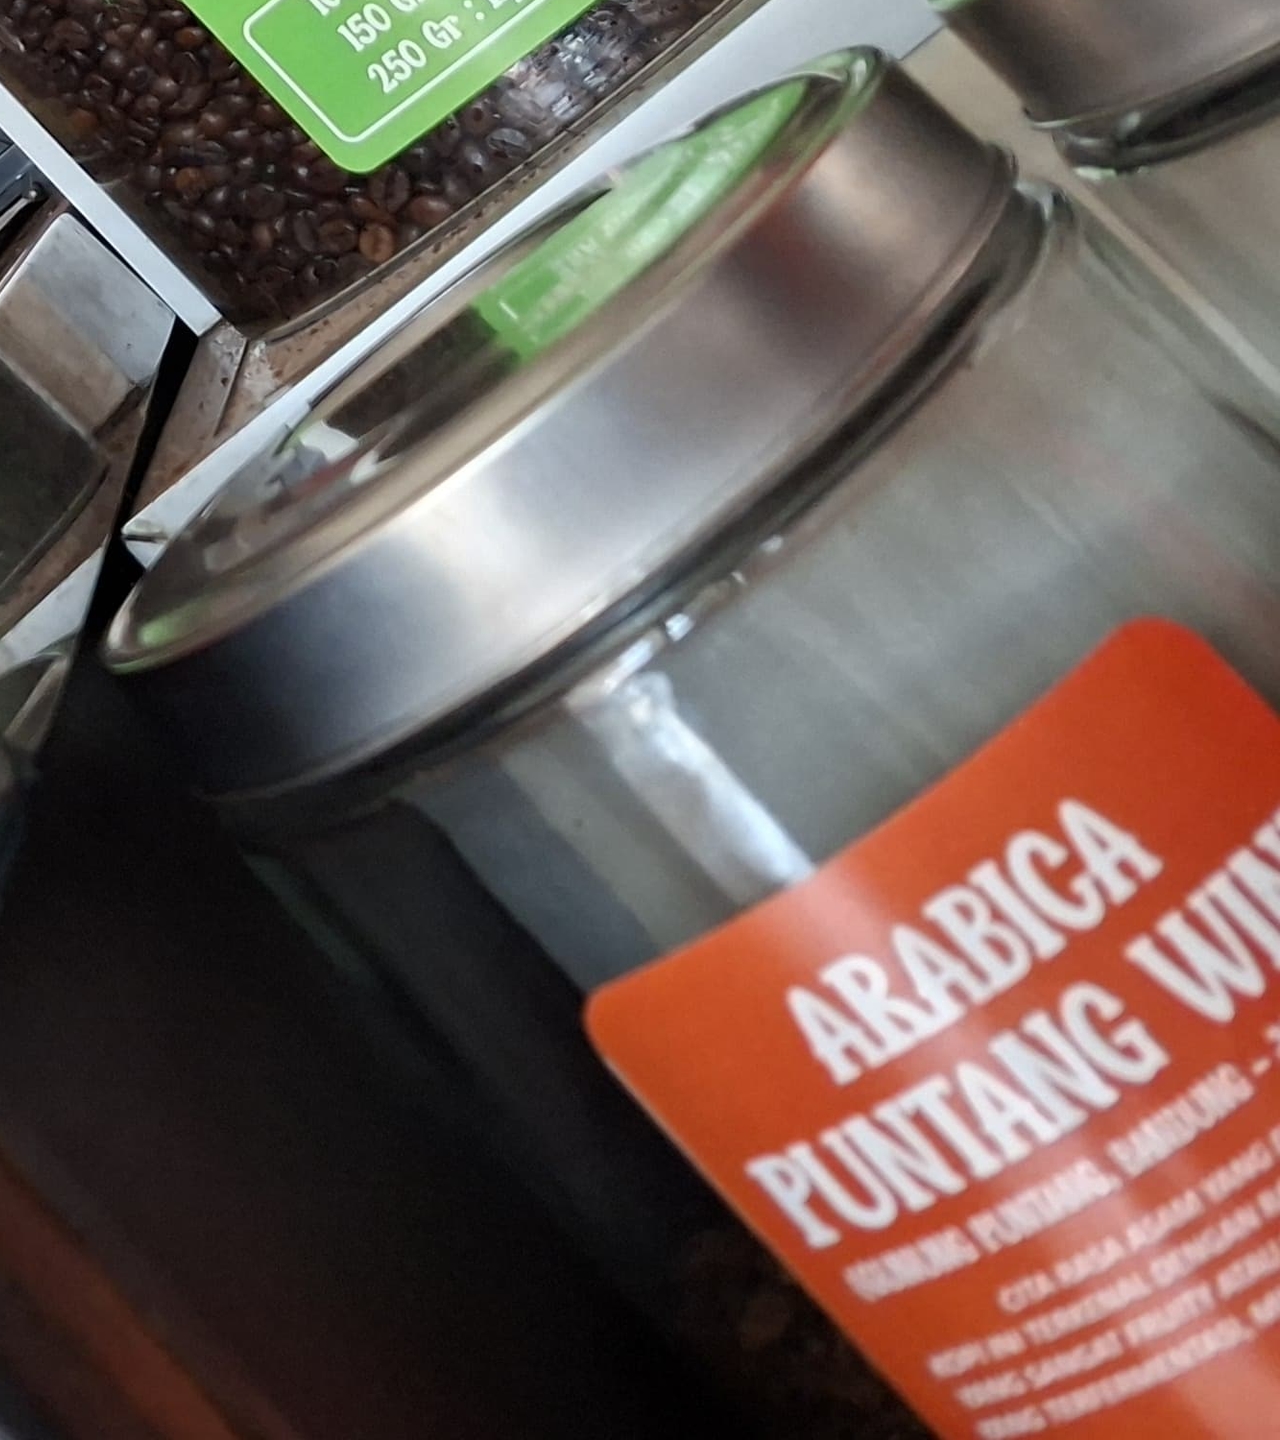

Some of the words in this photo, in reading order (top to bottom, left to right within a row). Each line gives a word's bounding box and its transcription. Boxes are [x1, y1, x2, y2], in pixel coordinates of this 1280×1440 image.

[337, 3, 392, 52] 150
[367, 39, 427, 93] 250
[422, 15, 462, 49] Gr
[790, 804, 1157, 1081] ARABICA
[752, 986, 1163, 1244] PUNTANG
